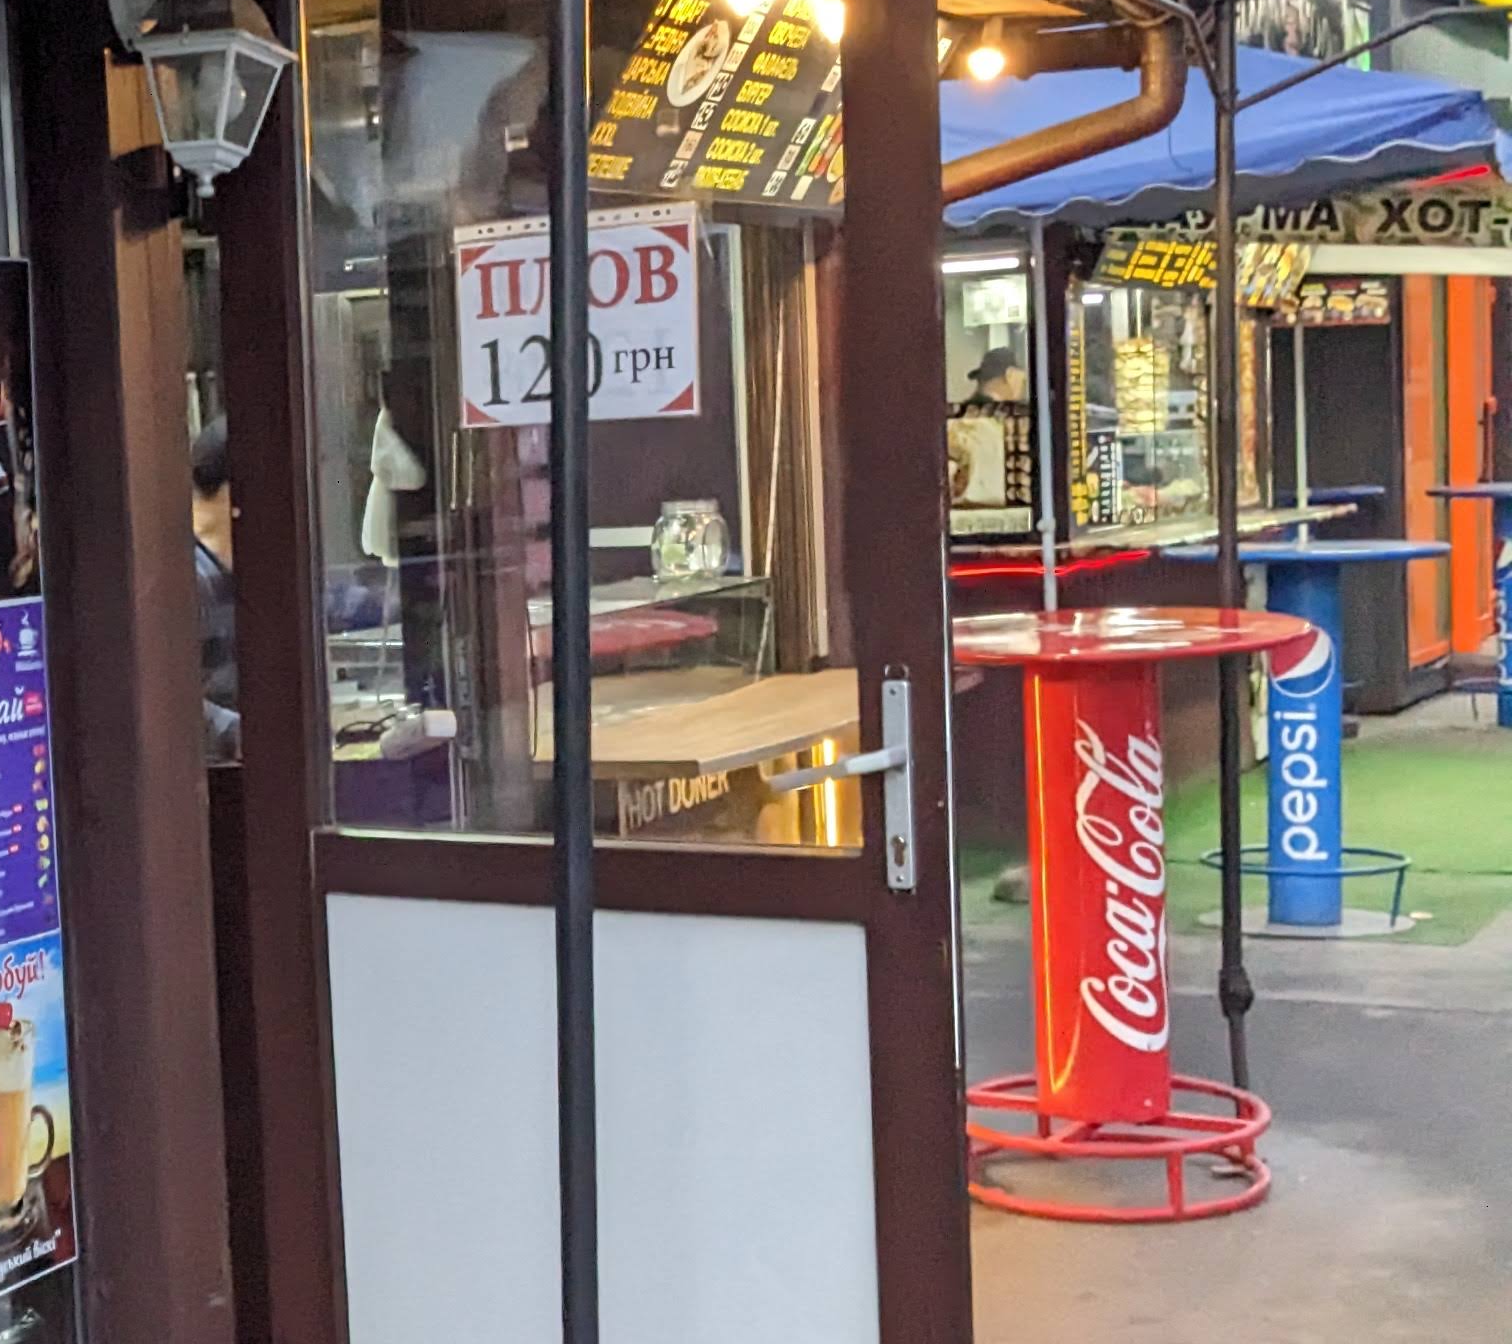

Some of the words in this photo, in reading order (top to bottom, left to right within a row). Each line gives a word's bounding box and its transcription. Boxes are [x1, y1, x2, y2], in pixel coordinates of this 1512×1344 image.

[614, 345, 676, 384] грн
[628, 779, 666, 830] HOT
[1282, 709, 1333, 861] pepsi
[1074, 718, 1170, 1054] Coca-Cola
